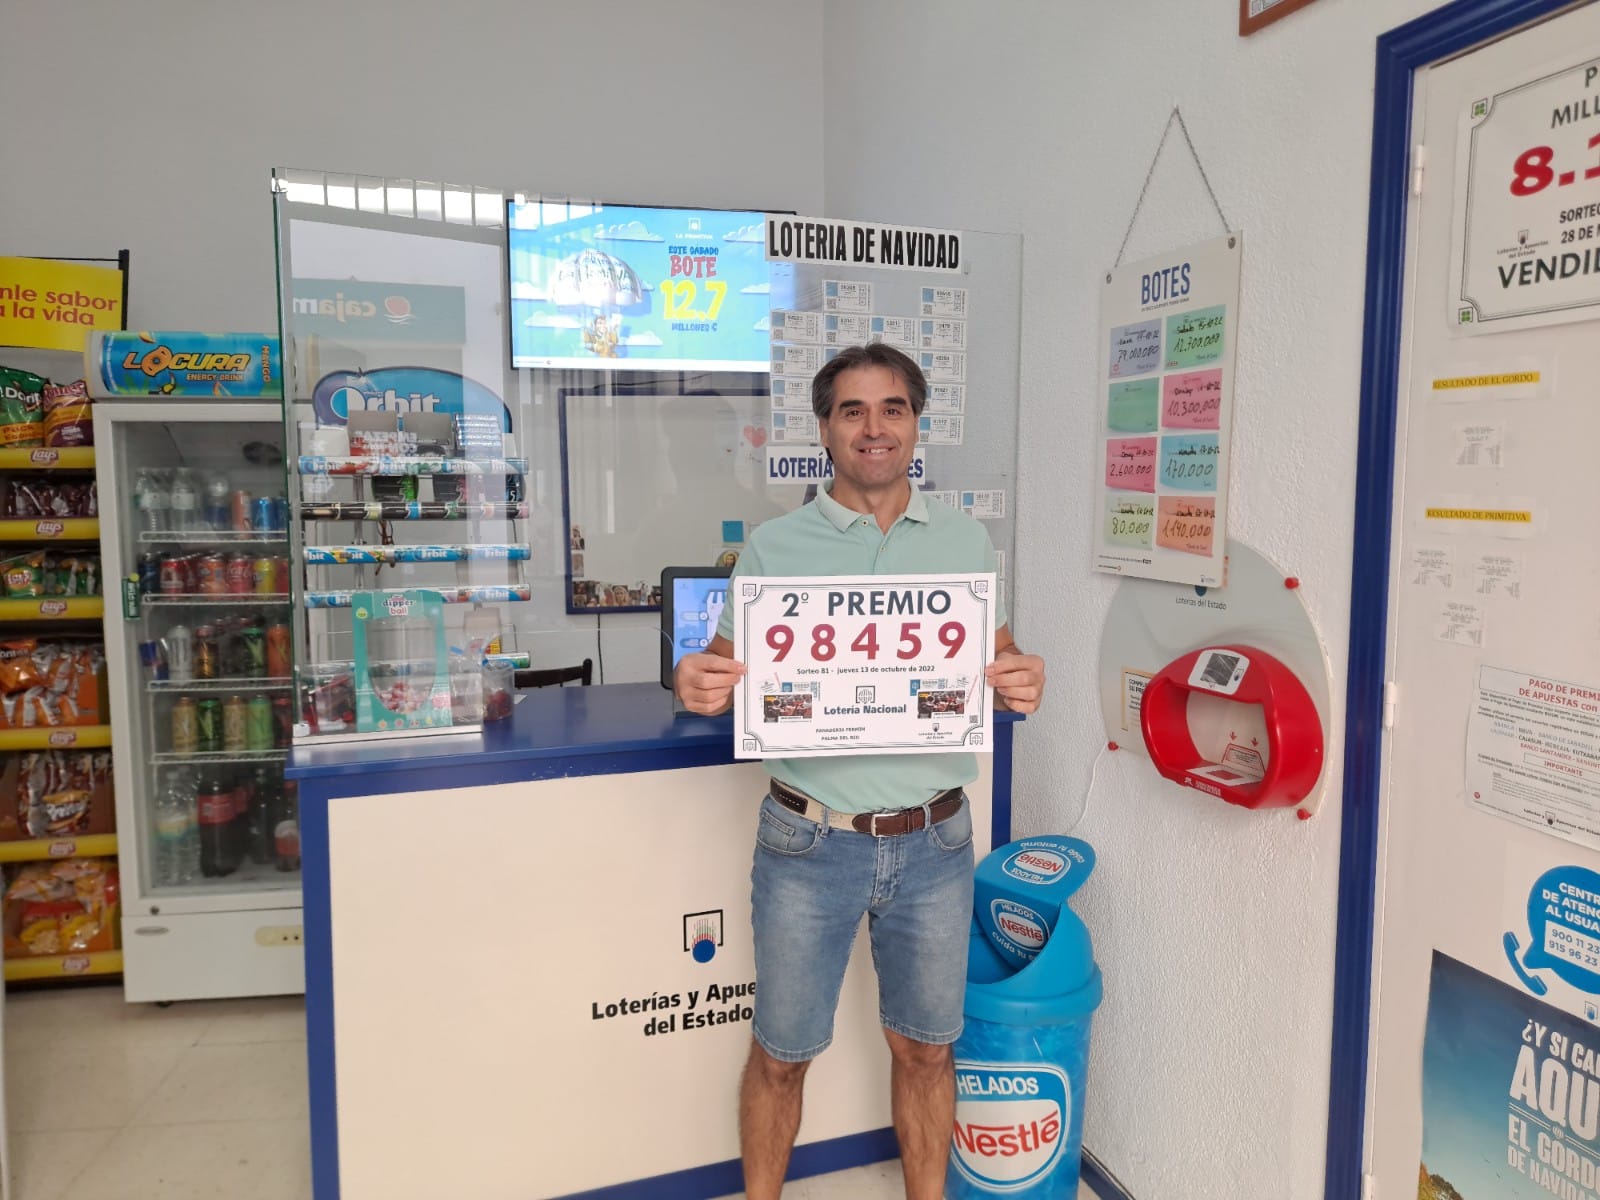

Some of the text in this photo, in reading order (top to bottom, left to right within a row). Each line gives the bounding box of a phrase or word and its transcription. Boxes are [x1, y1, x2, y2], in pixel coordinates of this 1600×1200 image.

[1551, 95, 1600, 129] MILL
[769, 220, 960, 269] LOTERIA DE NAVIDAD
[1561, 230, 1575, 244] 28
[1578, 225, 1593, 240] DE
[668, 246, 687, 254] ESTE
[670, 255, 717, 278] BOTE
[1141, 262, 1191, 305] BOTES
[46, 290, 117, 311] sabor
[660, 279, 728, 320] 12.7
[13, 302, 94, 325] la vida
[671, 322, 710, 332] MILLONES
[124, 345, 251, 376] LOCURA
[186, 373, 245, 381] ENERGY DRINK
[769, 452, 834, 478] LOTERÍA
[390, 607, 407, 615] ball
[781, 589, 952, 617] 2º PREMIO
[797, 667, 819, 675] Sorteo
[837, 667, 859, 675] jueves
[880, 665, 907, 673] octubre
[1529, 678, 1554, 691] PAGO
[1555, 684, 1567, 695] DE
[863, 704, 907, 714] Nacional
[1518, 687, 1598, 713] DE APUESTAS con
[1544, 760, 1583, 777] IMPORTANTE
[1542, 888, 1559, 903] DE
[1545, 904, 1600, 933] AL USUA
[1548, 940, 1599, 967] 915 96 23
[1551, 929, 1600, 955] 900 11 23
[592, 992, 680, 1020] Loterías
[687, 990, 699, 1010] y
[644, 1003, 754, 1036] del Estado
[1521, 1018, 1548, 1048] ¿Y
[1549, 1031, 1569, 1061] SI
[956, 1074, 1040, 1096] HELADOS
[1509, 1045, 1600, 1141] AQU
[952, 1109, 1060, 1158] Nestlé
[1508, 1113, 1531, 1153] EL
[1507, 1146, 1600, 1200] DE NAVID
